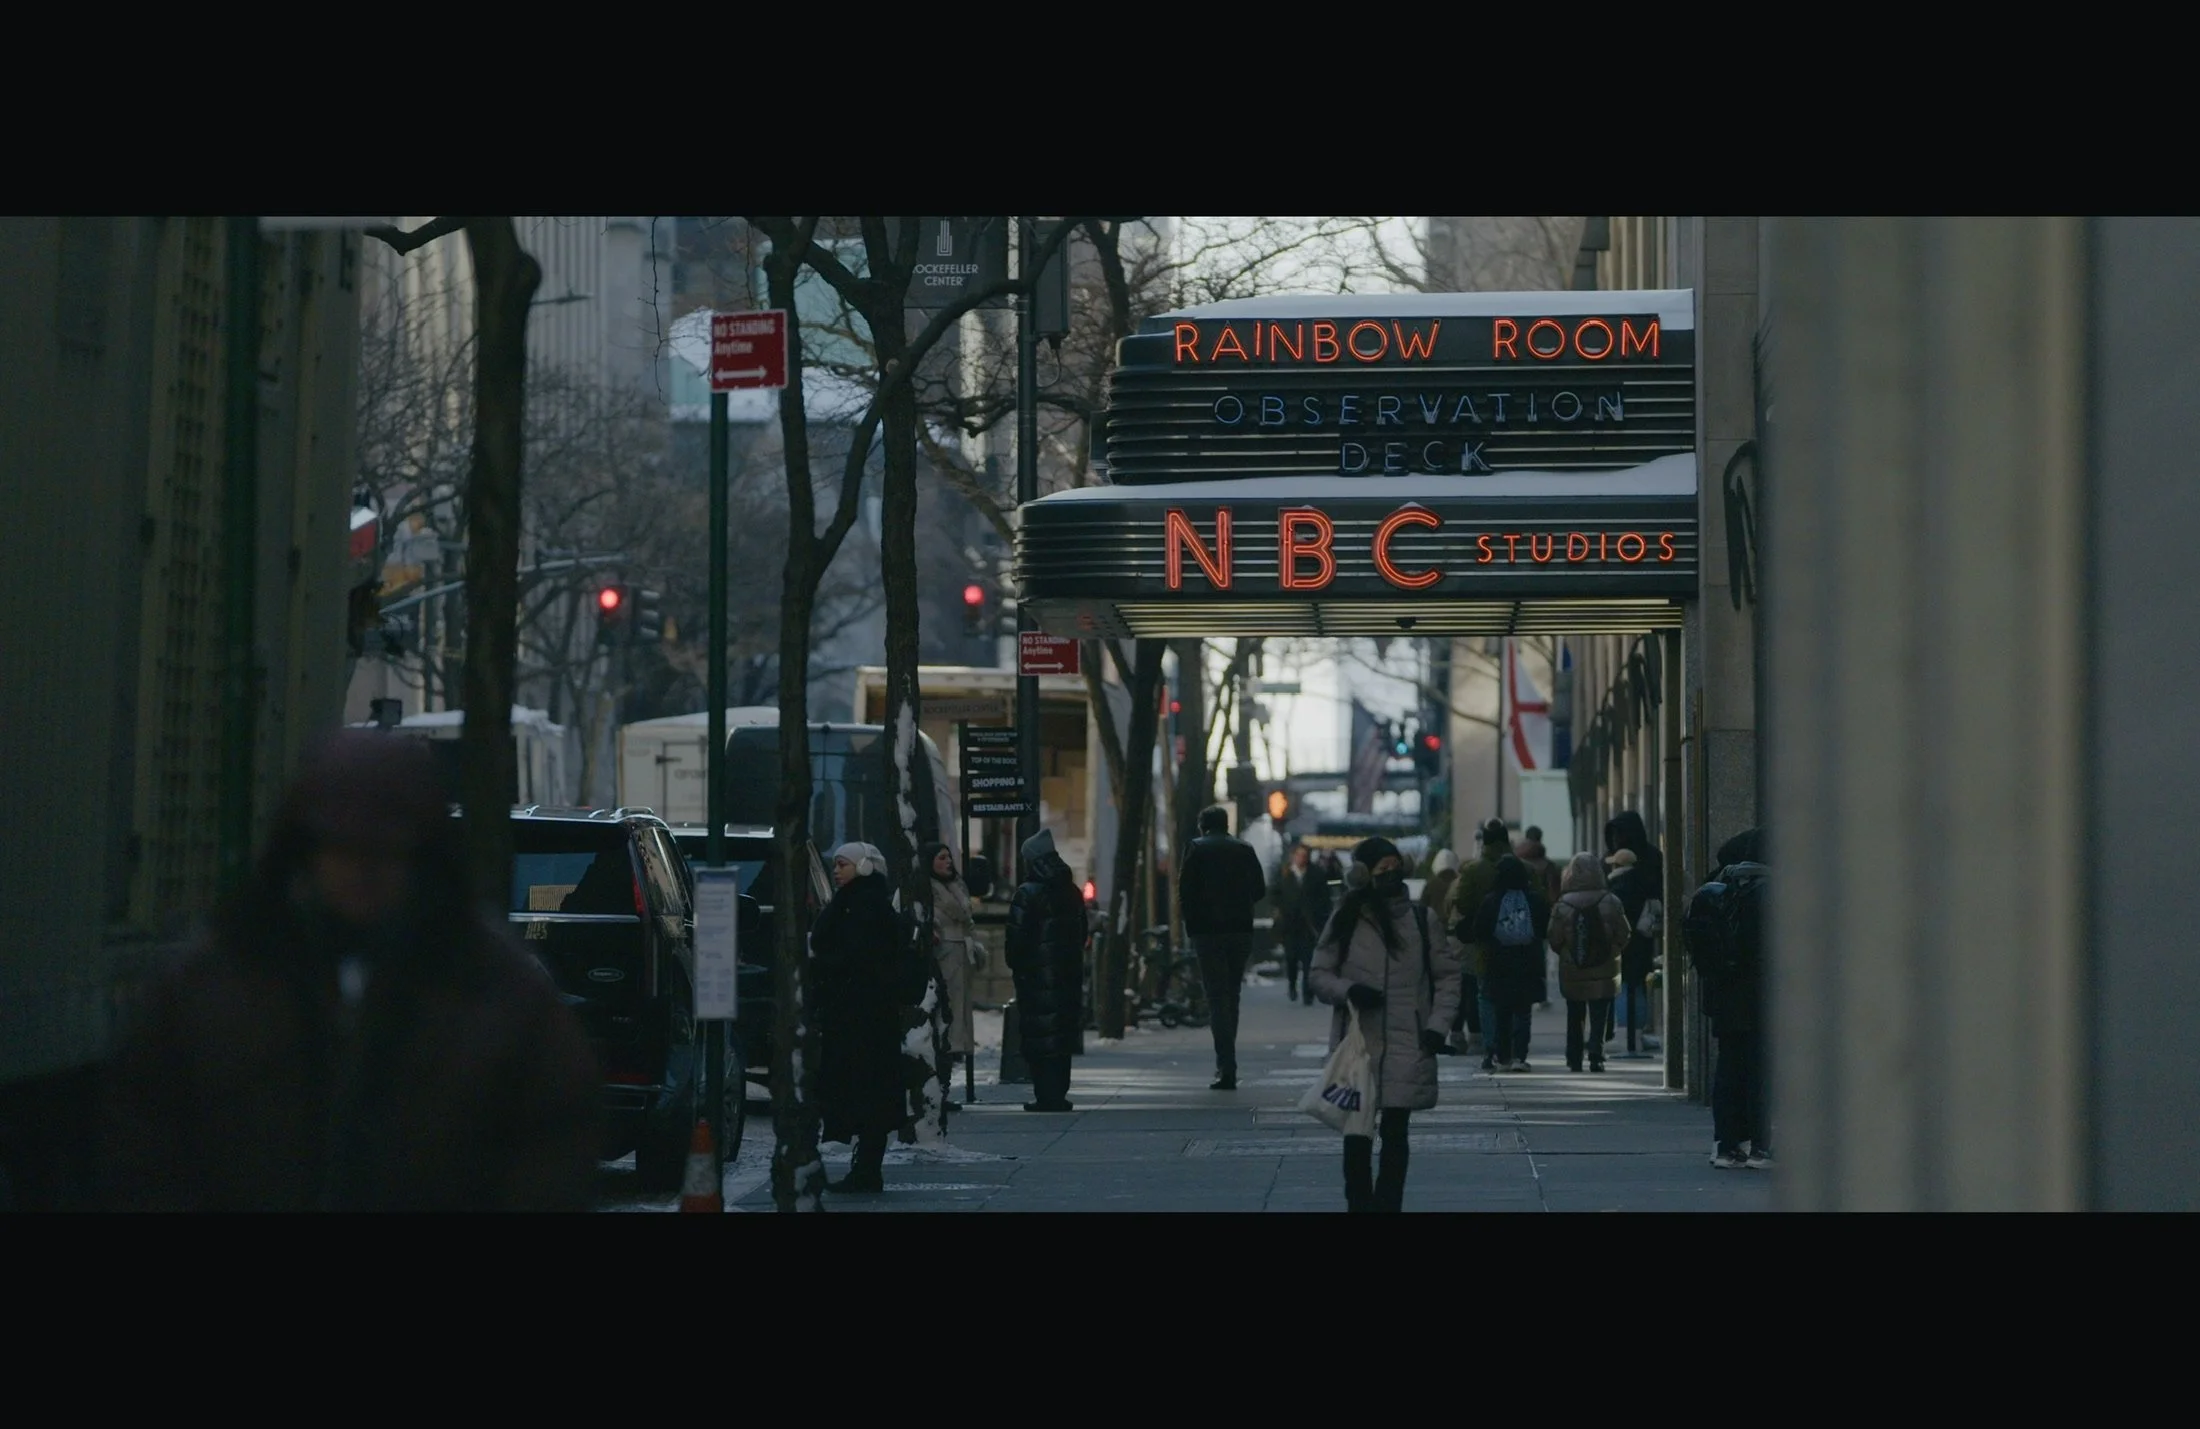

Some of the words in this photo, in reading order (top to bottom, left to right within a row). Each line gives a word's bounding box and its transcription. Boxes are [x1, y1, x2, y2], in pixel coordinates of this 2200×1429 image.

[924, 276, 963, 286] CENTER
[713, 323, 728, 338] NO
[729, 318, 776, 337] STANDING
[1174, 319, 1441, 363] RAINBOW
[1492, 316, 1661, 361] ROOM
[714, 340, 753, 358] Anytime
[1213, 390, 1626, 425] OBSERVATION
[1340, 440, 1494, 475] DECK
[1165, 506, 1442, 590] NBC
[1476, 530, 1677, 564] STUDIOS
[1022, 636, 1033, 645] NO
[1022, 646, 1053, 657] Anytime
[971, 776, 1016, 788] SHOPPING
[972, 803, 1025, 812] RESTAURANTS
